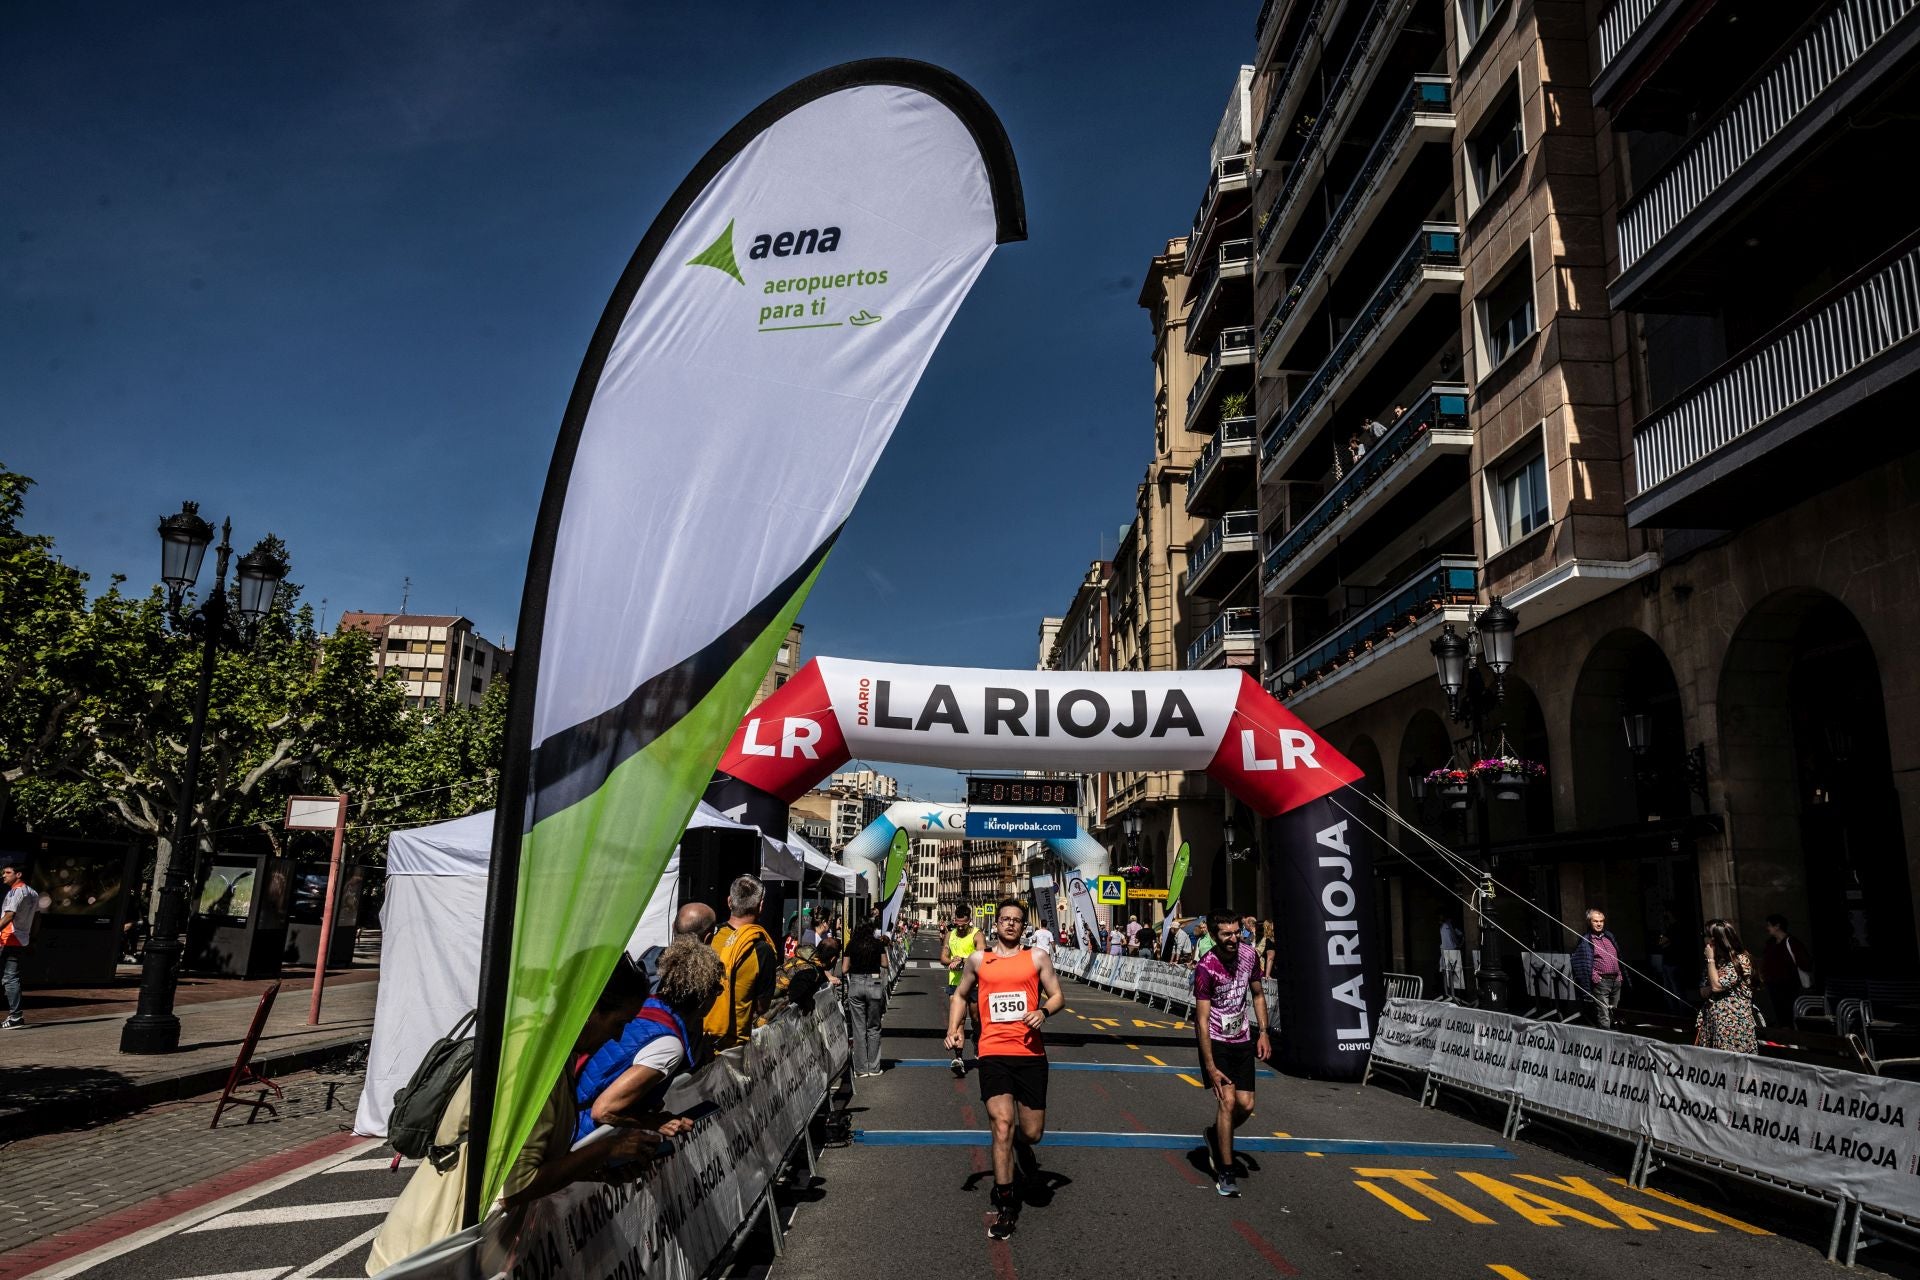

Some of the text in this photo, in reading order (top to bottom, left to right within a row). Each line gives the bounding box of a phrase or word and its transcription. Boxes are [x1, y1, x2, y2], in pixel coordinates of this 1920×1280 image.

[750, 226, 841, 260] aena
[763, 269, 888, 295] aeropuertos
[759, 297, 826, 325] para ti
[858, 678, 870, 726] DIARIO
[874, 680, 1204, 739] LA RIOJA
[741, 717, 822, 760] LR
[1241, 729, 1322, 771] LR
[988, 820, 1061, 832] Kirolprobak.com
[1316, 819, 1370, 1040] LA RIOJA
[992, 1001, 1025, 1013] 1350
[1456, 1021, 1475, 1034] RIOJA
[1490, 1028, 1512, 1043] RIOJA
[1338, 1042, 1371, 1051] DIARIO
[1450, 1044, 1470, 1058] RIOJA
[1528, 1036, 1555, 1052] RIOJA
[1562, 1041, 1602, 1062] LA RIOJA
[1484, 1052, 1506, 1068] RIOJA
[1521, 1060, 1548, 1079] RIOJA
[1611, 1050, 1657, 1073] LA RIOJA
[1555, 1068, 1596, 1091] LA RIOJA
[1666, 1062, 1726, 1089] LA RIOJA
[1604, 1080, 1650, 1104] LA RIOJA
[1738, 1076, 1808, 1108] LA RIOJA
[1660, 1093, 1677, 1112] LA
[1678, 1100, 1718, 1124] RIOJA
[1822, 1093, 1845, 1116] LA
[1848, 1099, 1905, 1128] RIOJA
[1731, 1112, 1751, 1130] LA
[1753, 1117, 1800, 1146] RIOJA
[1814, 1132, 1837, 1156] LA
[1839, 1137, 1897, 1170] RIOJA
[587, 1184, 629, 1234] RIOJA
